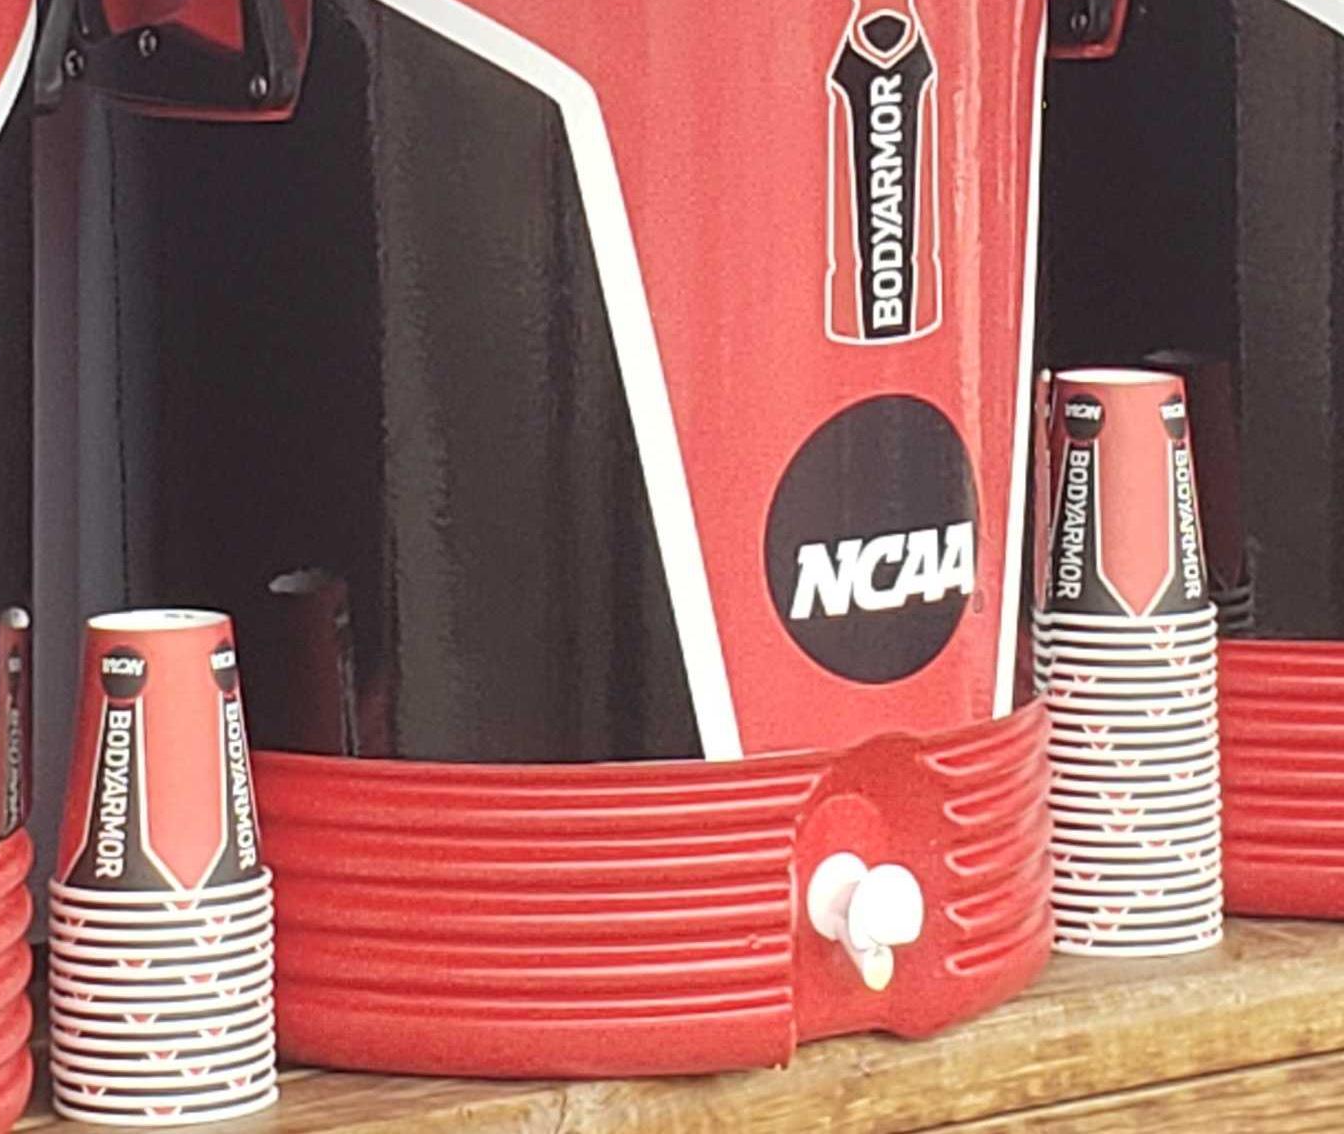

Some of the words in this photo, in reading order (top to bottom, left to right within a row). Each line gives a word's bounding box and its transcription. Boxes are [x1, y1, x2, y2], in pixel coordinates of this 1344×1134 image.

[870, 73, 903, 329] BODYARMOR
[790, 521, 974, 619] NCAA
[1056, 449, 1090, 599] BODYARMOR
[1175, 449, 1202, 599] BODYARMOR
[96, 709, 132, 879] BODYARMOR
[223, 701, 258, 870] BODYARMOR
